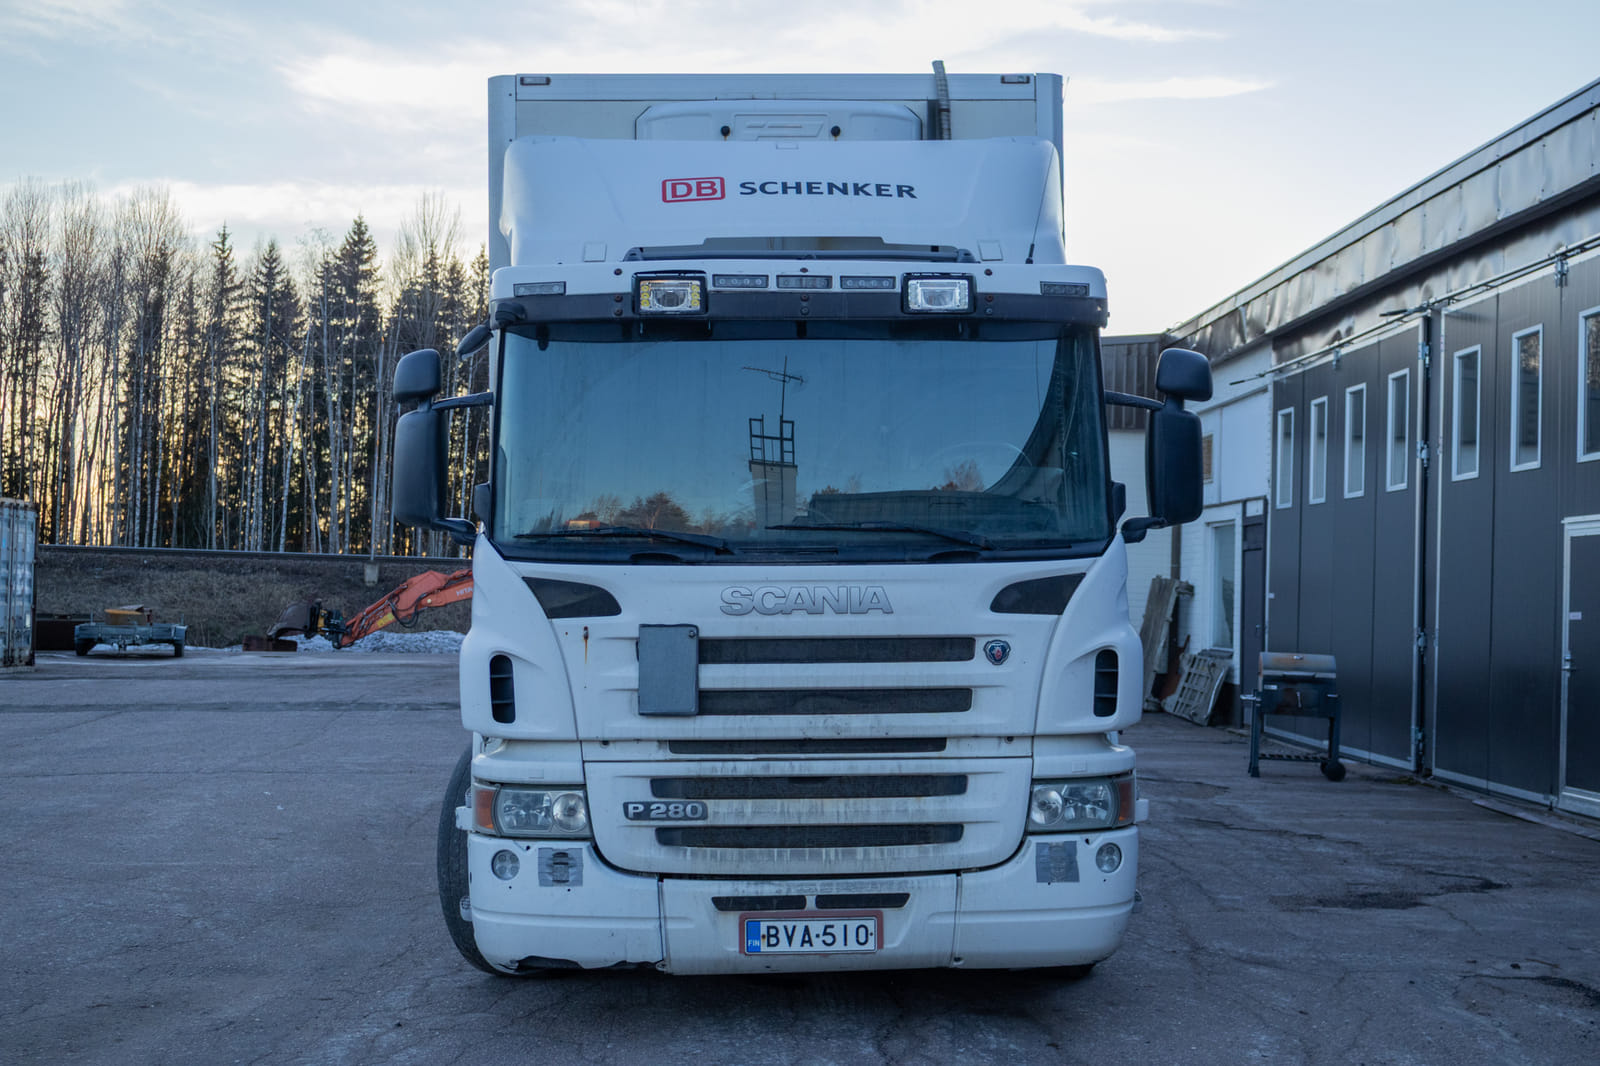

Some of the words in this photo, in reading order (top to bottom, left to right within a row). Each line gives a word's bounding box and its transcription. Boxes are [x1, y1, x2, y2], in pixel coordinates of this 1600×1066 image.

[671, 180, 718, 199] DB
[739, 181, 917, 199] SCHENKER
[720, 586, 894, 616] SCANIA
[627, 803, 645, 818] P
[649, 803, 703, 818] 280
[747, 939, 760, 947] FIN
